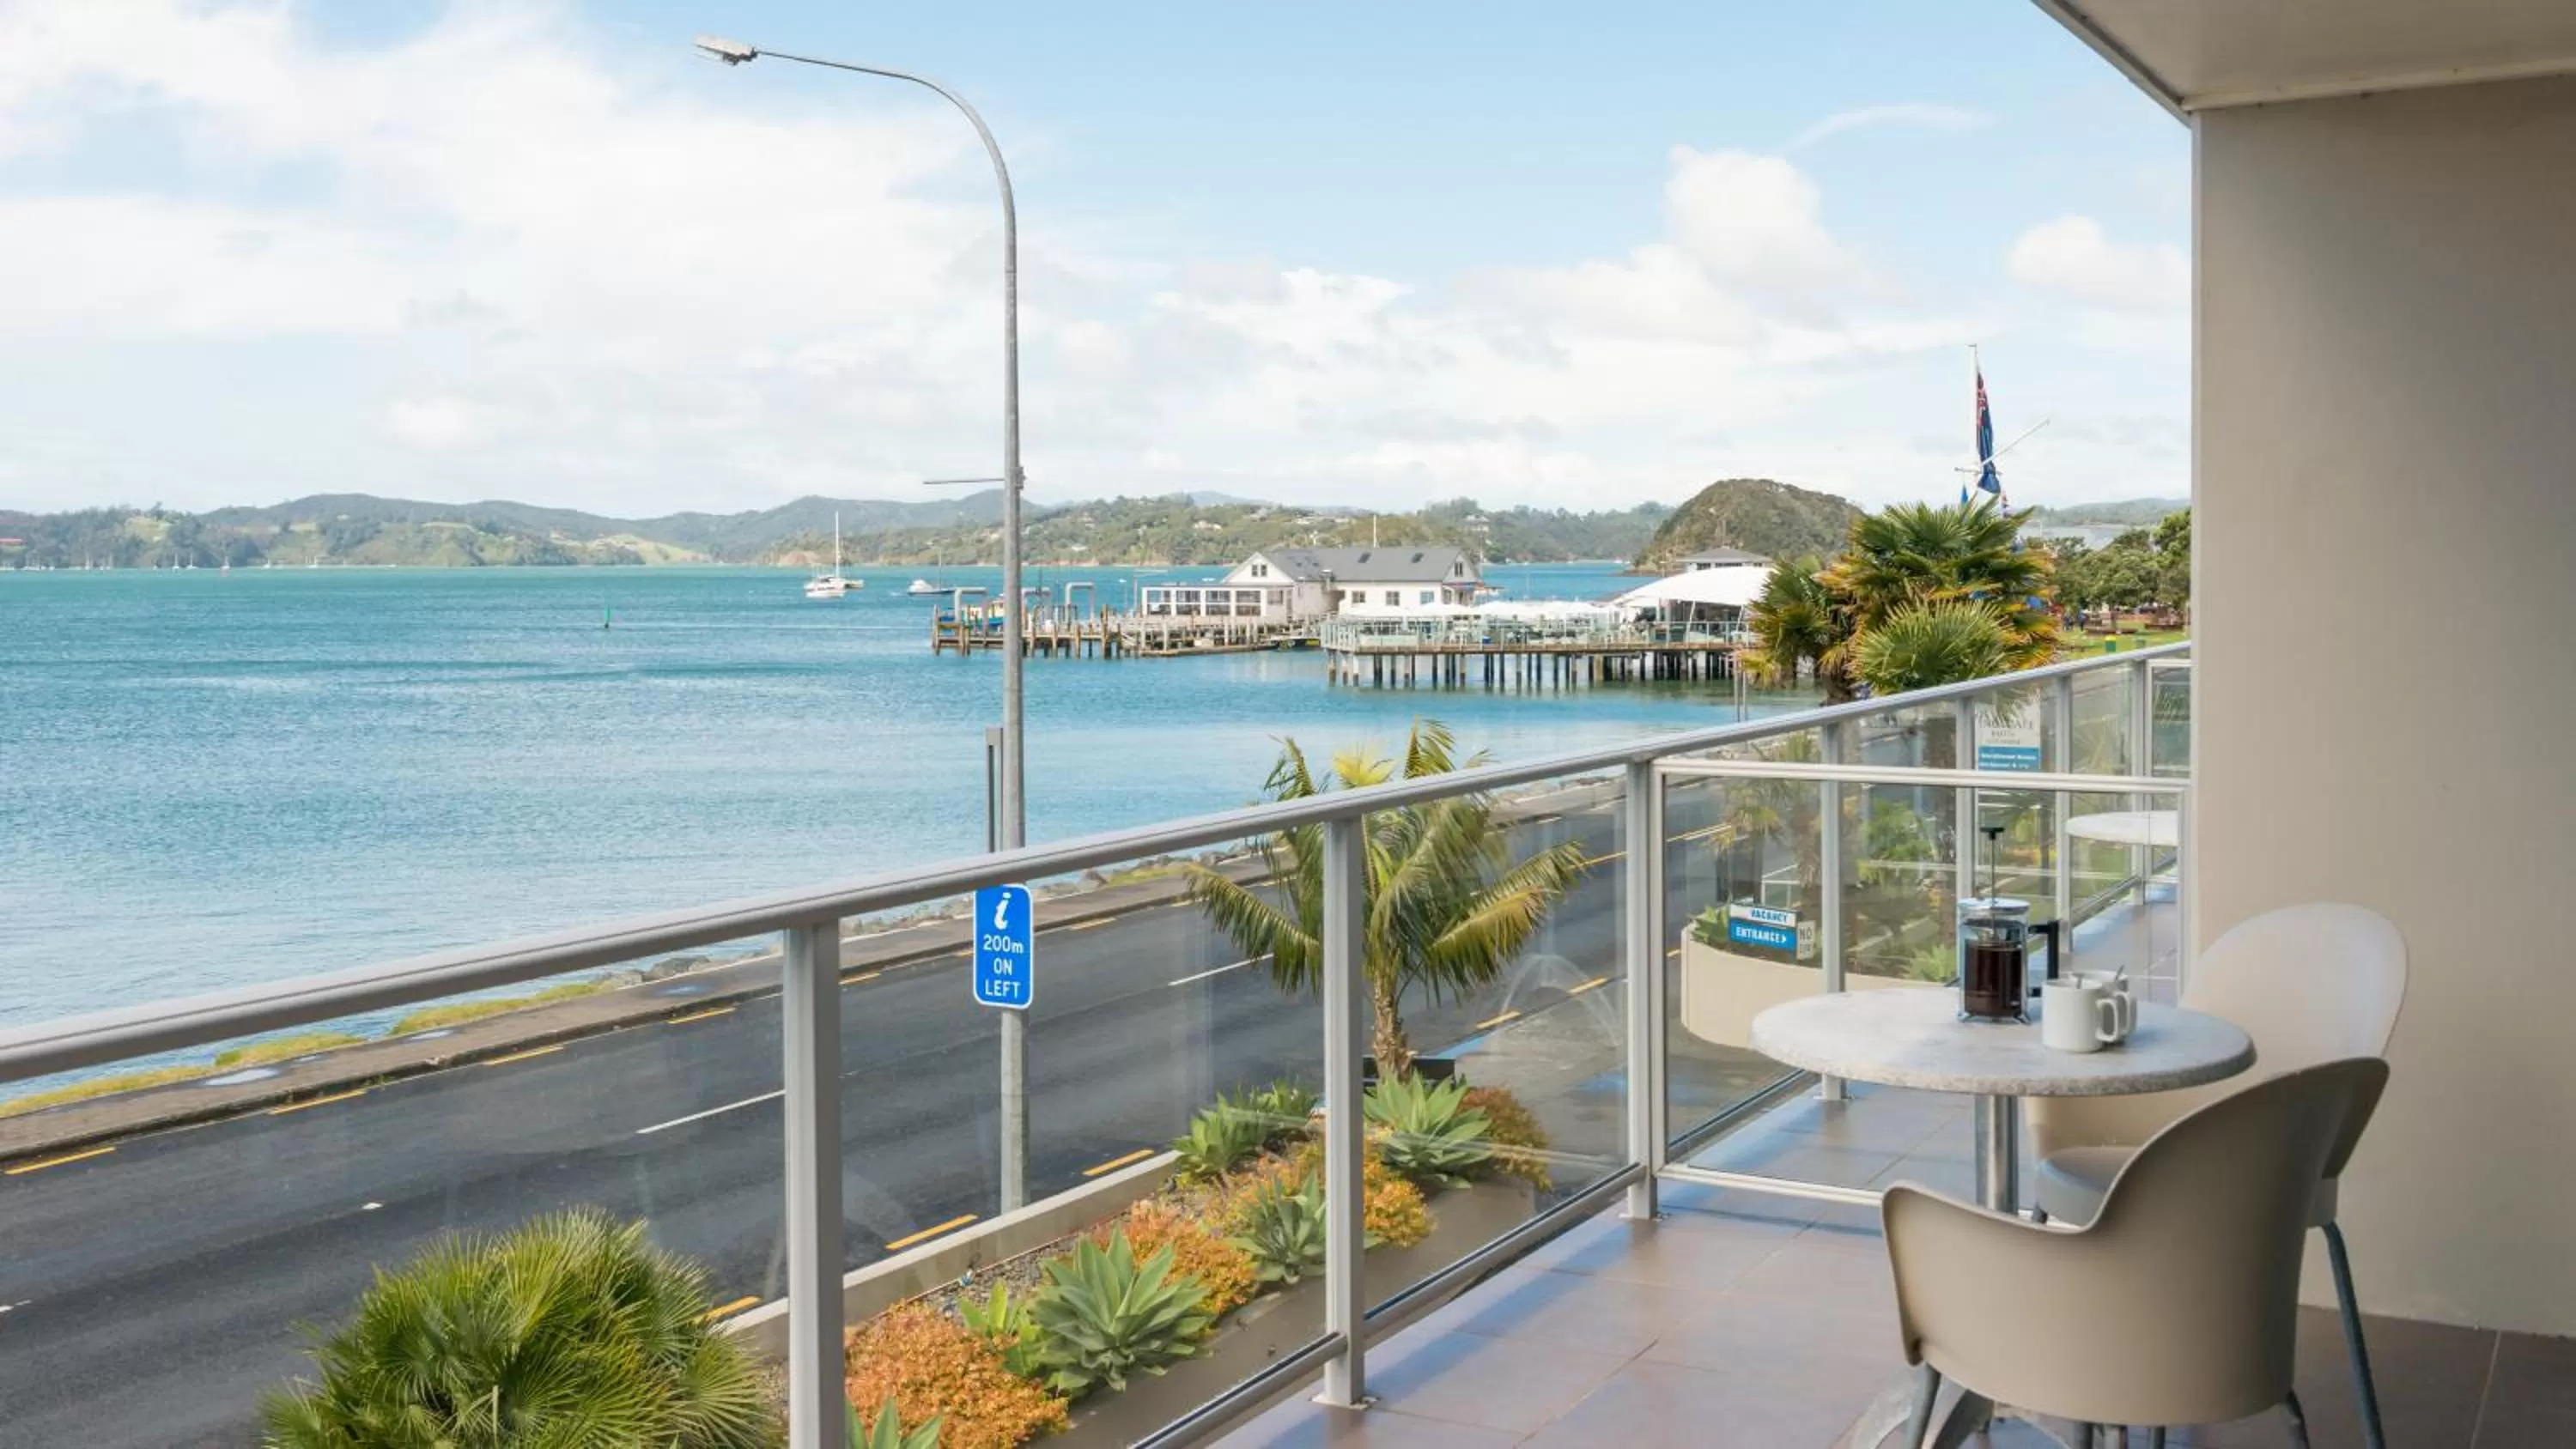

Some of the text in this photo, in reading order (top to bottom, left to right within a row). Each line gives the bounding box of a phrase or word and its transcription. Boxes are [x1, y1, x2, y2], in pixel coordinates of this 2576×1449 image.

[1750, 908, 1789, 925] VACANCY
[1735, 926, 1781, 943] ENTRANCE
[1799, 927, 1813, 941] NO
[982, 934, 1024, 954] 200m
[993, 957, 1012, 975] ON
[985, 979, 1022, 998] LEFT
